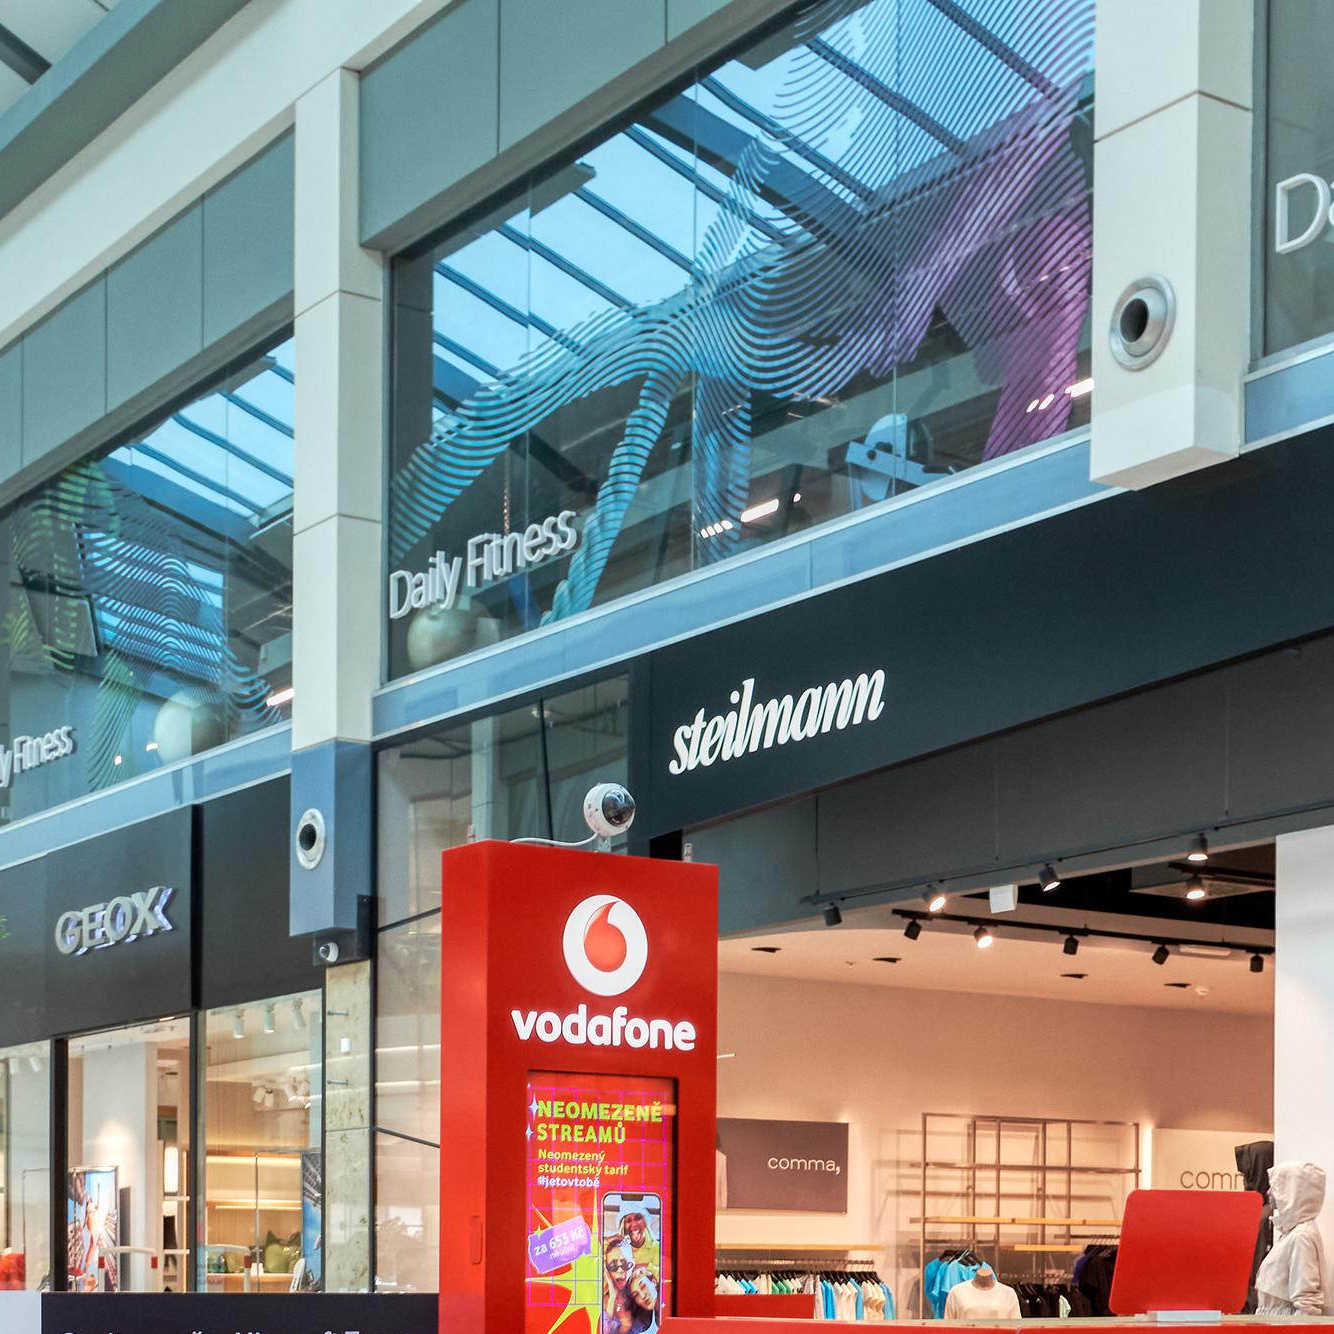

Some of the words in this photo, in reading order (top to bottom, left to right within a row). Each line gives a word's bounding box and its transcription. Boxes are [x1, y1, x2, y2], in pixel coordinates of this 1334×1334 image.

[389, 549, 460, 619] Daily
[467, 509, 578, 588] Fitness
[669, 668, 885, 776] steilmann
[13, 724, 76, 778] Fitness
[54, 886, 171, 955] GEOX
[511, 1003, 697, 1052] vodafone
[537, 1100, 662, 1122] NEOMEZENĚ
[537, 1122, 626, 1144] STREAMŮ
[538, 1149, 605, 1162] Neomezený
[767, 1157, 841, 1176] comma,
[538, 1163, 602, 1175] studentský
[604, 1165, 629, 1175] tarif
[537, 1176, 600, 1187] #jetovtobě
[534, 1243, 548, 1256] za
